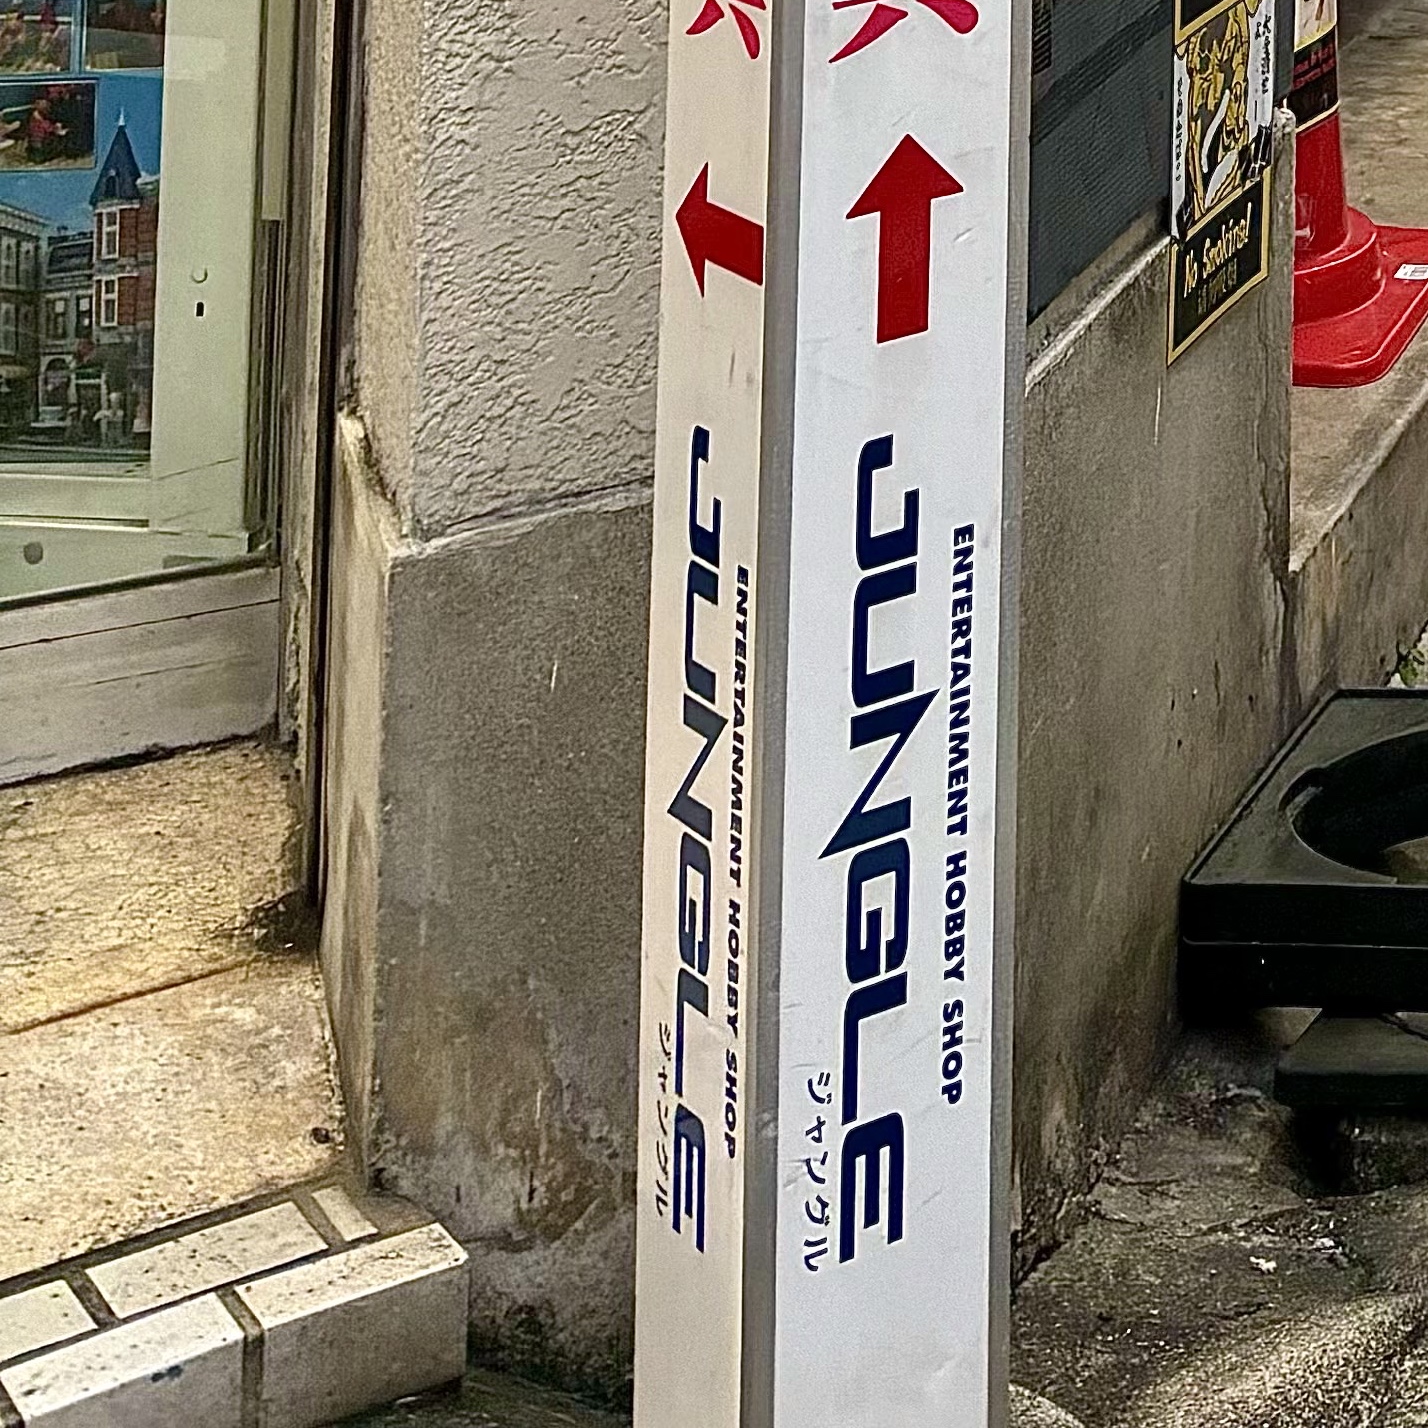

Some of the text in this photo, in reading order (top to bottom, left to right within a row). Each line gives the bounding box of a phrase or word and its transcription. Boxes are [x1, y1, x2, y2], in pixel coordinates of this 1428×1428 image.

[1184, 254, 1200, 300] No
[665, 423, 728, 1255] JUNGLE
[722, 565, 751, 1159] ENTERTAINMENT HOBBY SHOP
[816, 433, 940, 1267] JUNGLE
[940, 522, 975, 1106] ENTERTAINMENT HOBBY SHOP
[653, 1024, 676, 1218] ジャングル
[801, 1071, 831, 1274] ジャングル
